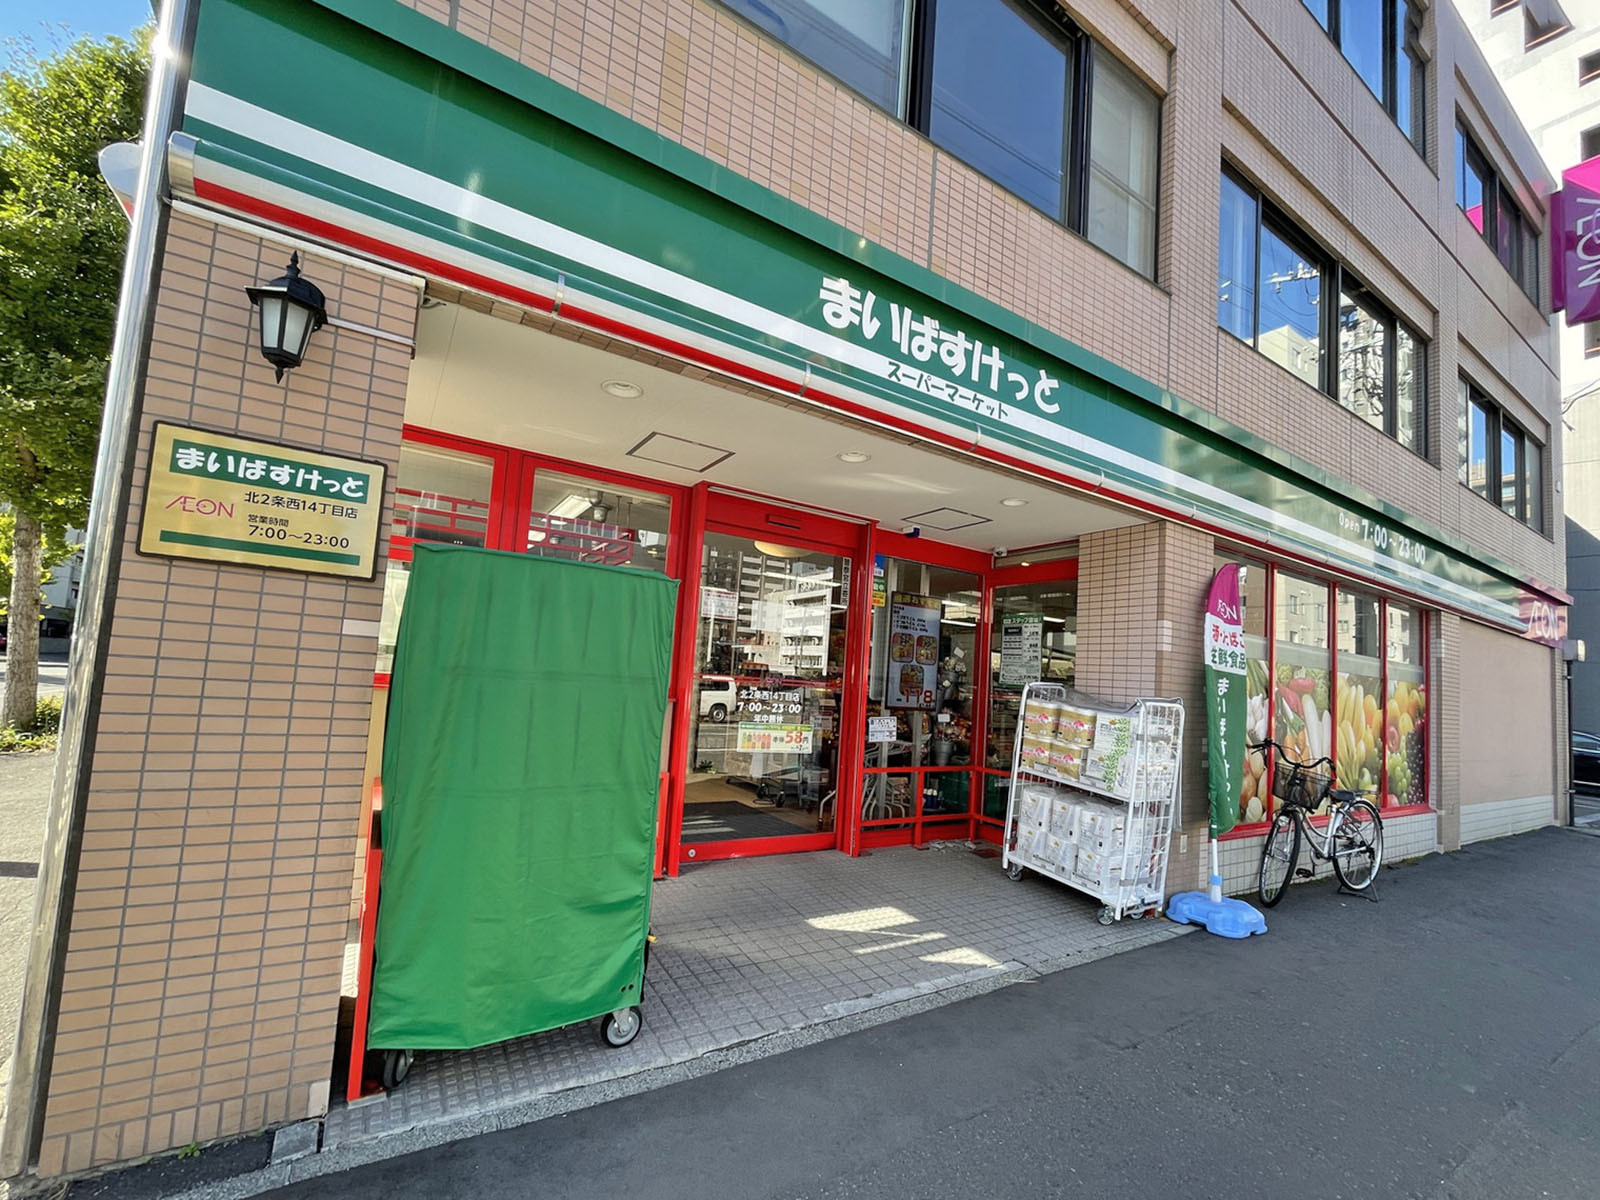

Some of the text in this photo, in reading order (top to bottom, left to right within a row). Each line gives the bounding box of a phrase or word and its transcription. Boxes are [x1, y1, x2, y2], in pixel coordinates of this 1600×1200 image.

[819, 276, 1061, 414] まいばすけっと
[887, 360, 1009, 420] スーパーマーケット
[175, 446, 364, 498] まいばすけっと
[244, 490, 359, 520] 北2条西14丁目店
[247, 513, 289, 527] 営業時間
[739, 689, 800, 702] 北2条西14丁目店
